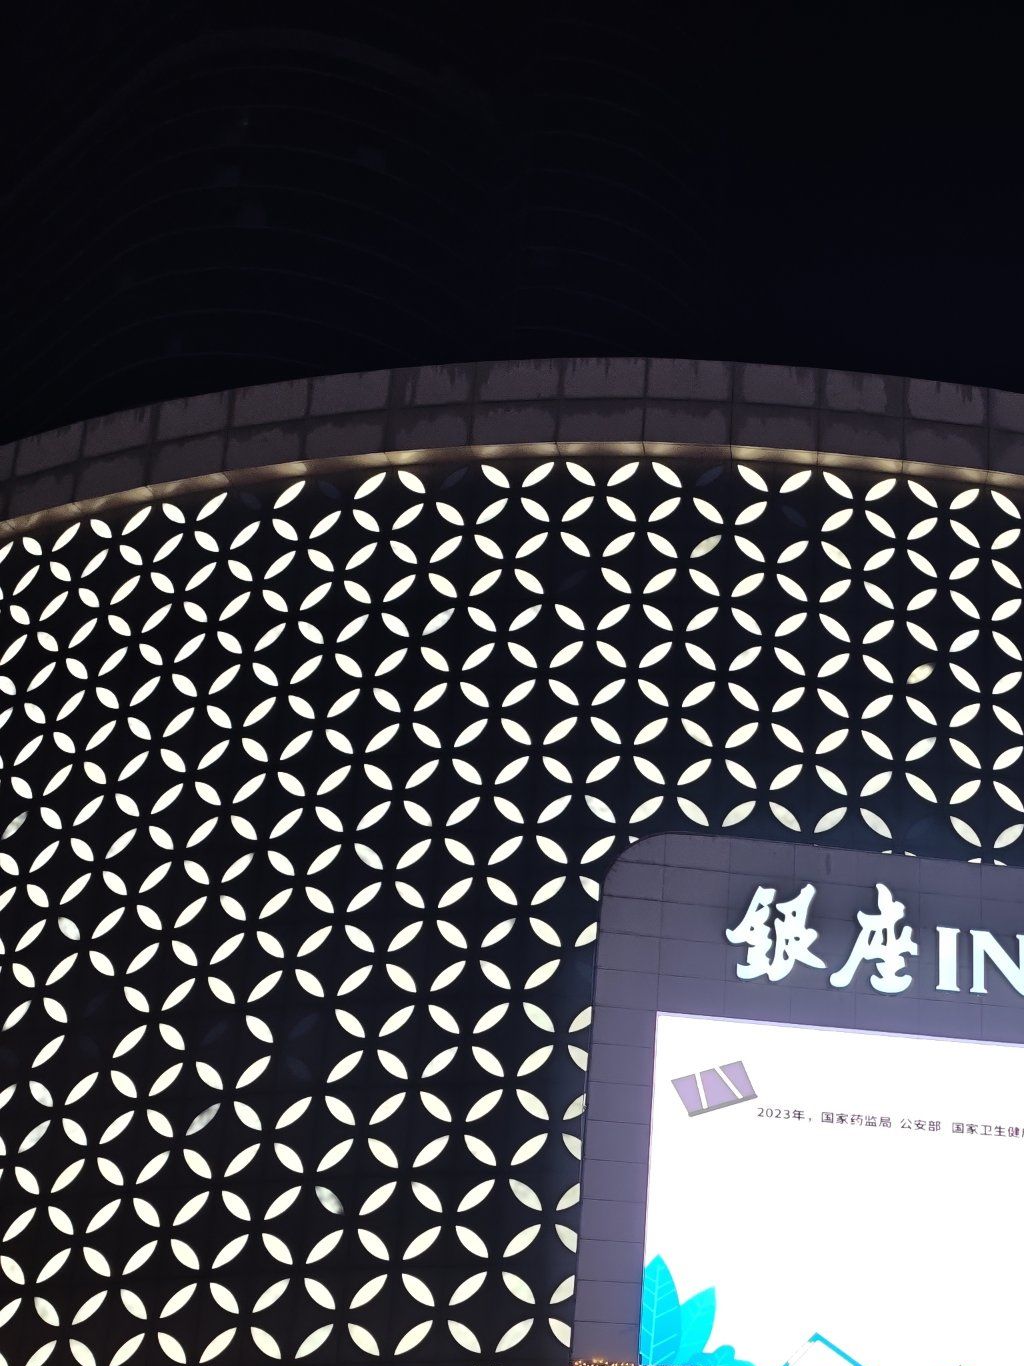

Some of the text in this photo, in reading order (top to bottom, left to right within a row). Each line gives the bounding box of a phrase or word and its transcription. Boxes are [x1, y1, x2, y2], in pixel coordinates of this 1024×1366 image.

[725, 883, 919, 996] 銀座
[900, 1118, 941, 1132] 公安部
